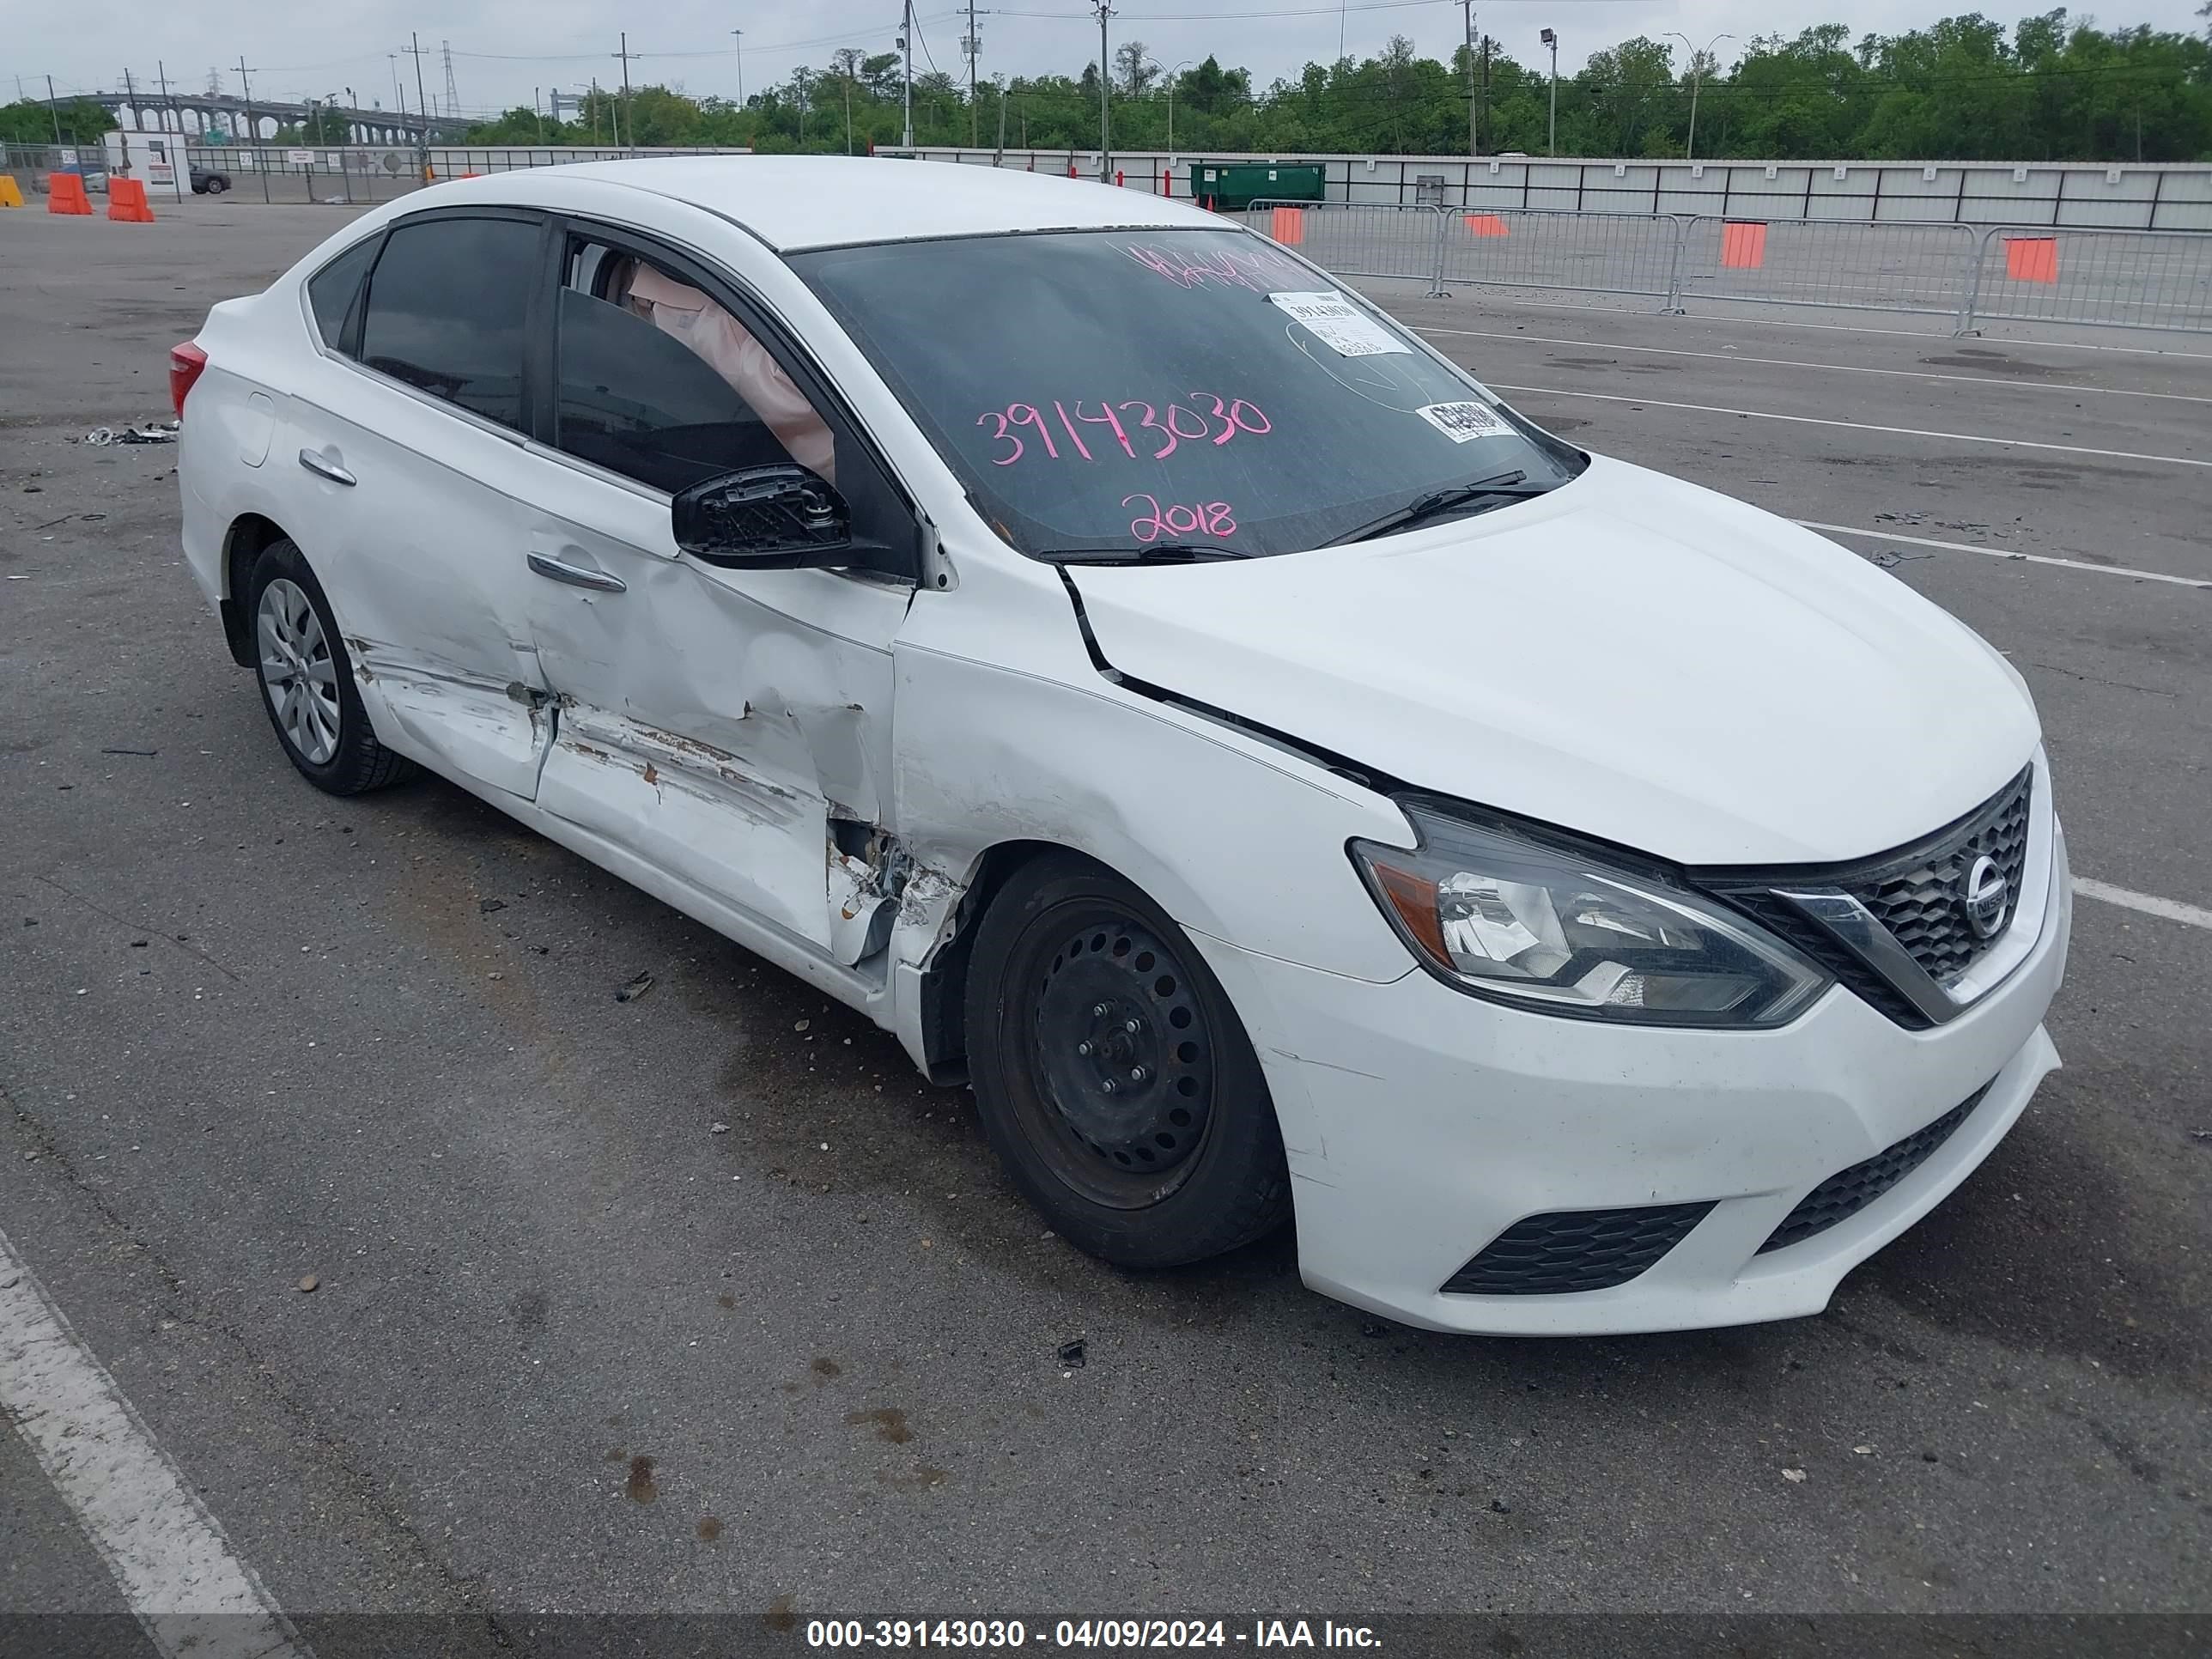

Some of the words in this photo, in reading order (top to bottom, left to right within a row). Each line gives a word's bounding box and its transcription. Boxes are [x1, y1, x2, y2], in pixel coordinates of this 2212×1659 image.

[1290, 305, 1357, 318] 39143030
[976, 392, 1272, 465] 39143030
[1121, 494, 1237, 542] 2018
